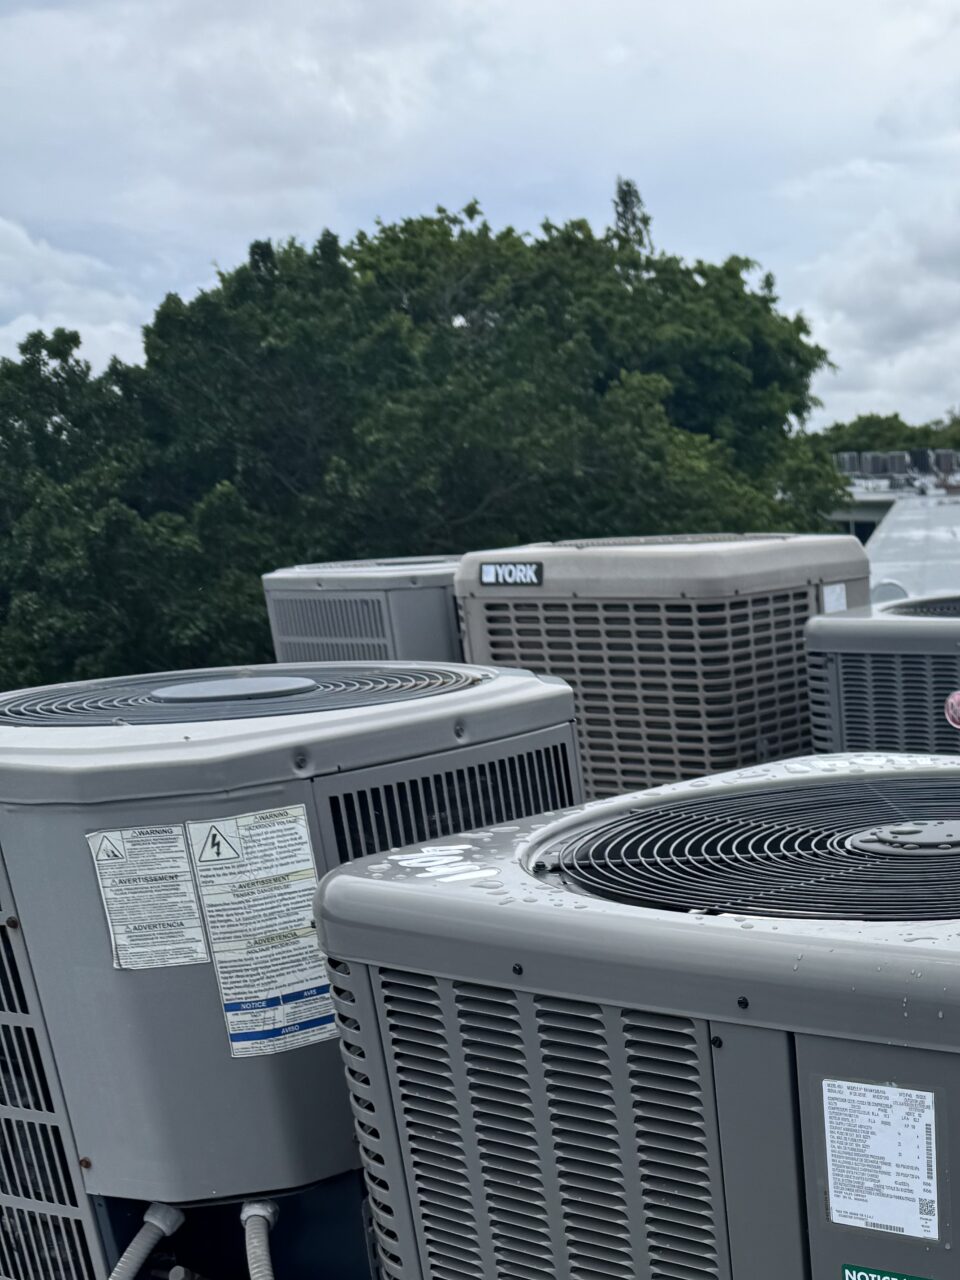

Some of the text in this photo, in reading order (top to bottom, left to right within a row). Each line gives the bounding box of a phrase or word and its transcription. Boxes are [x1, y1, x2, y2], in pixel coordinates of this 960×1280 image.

[495, 563, 538, 583] YORK
[259, 811, 288, 821] WARNING
[119, 874, 178, 885] AVERTISSEMENT
[238, 875, 289, 889] AVERTISSEMENT
[133, 921, 184, 930] ADVERTENCIA
[254, 931, 298, 945] ADVERTENCIA
[241, 1001, 266, 1009] NOTICE
